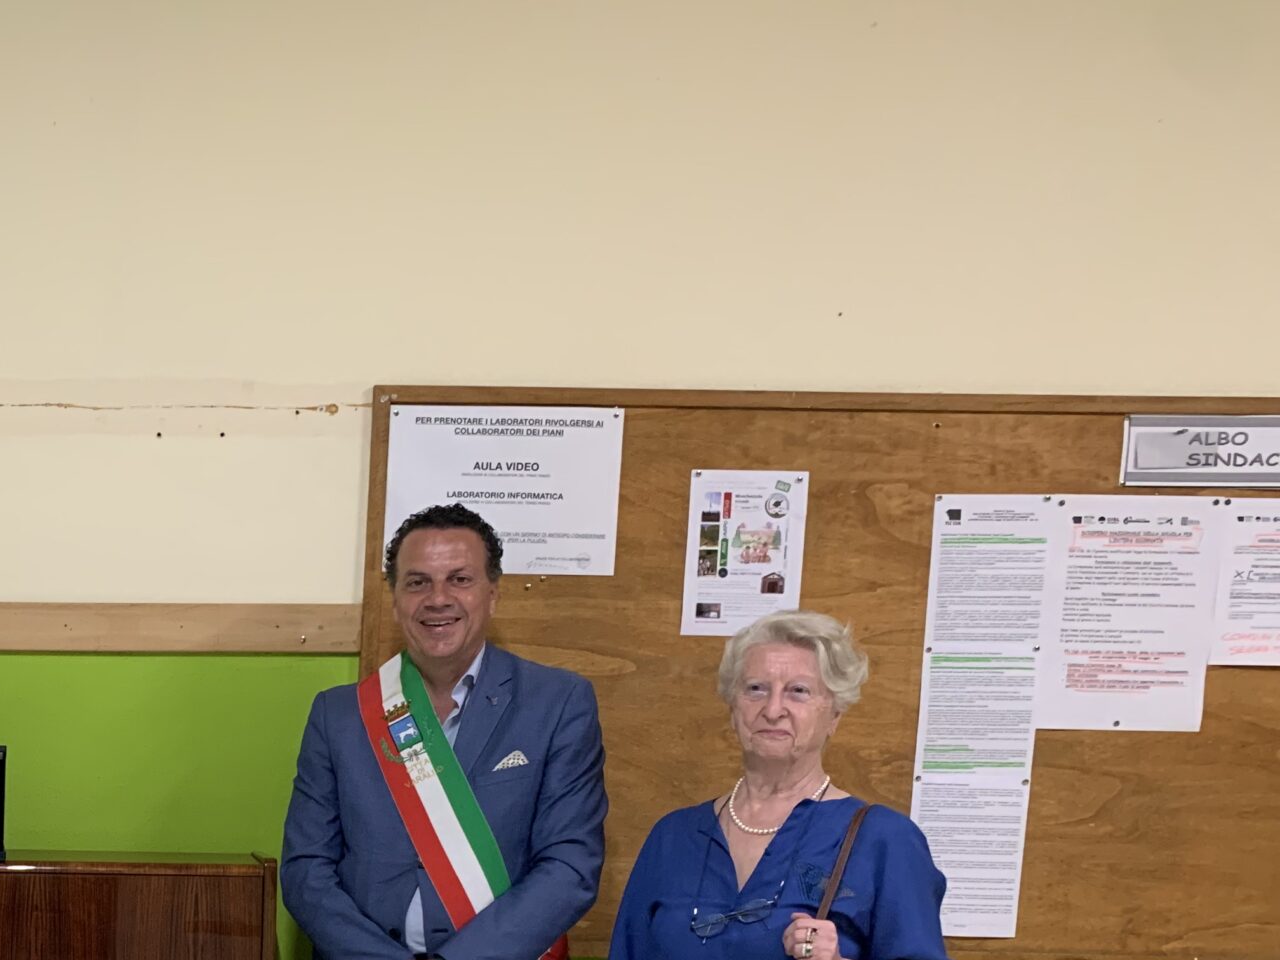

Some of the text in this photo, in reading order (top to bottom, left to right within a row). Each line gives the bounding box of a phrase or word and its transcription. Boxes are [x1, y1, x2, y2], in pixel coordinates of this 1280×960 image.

[415, 416, 432, 425] PER
[434, 417, 484, 426] PRENOTARE
[490, 418, 543, 427] LABORATORI
[545, 419, 594, 428] RIVOLGERSI
[596, 420, 604, 428] AI
[454, 428, 564, 437] COLLABORATORI DEI PIANI
[1188, 431, 1249, 446] ALBO
[1185, 452, 1280, 467] SINDAC
[473, 461, 540, 472] AULA VIDEO
[446, 491, 564, 500] LABORATORIO INFORMATICA
